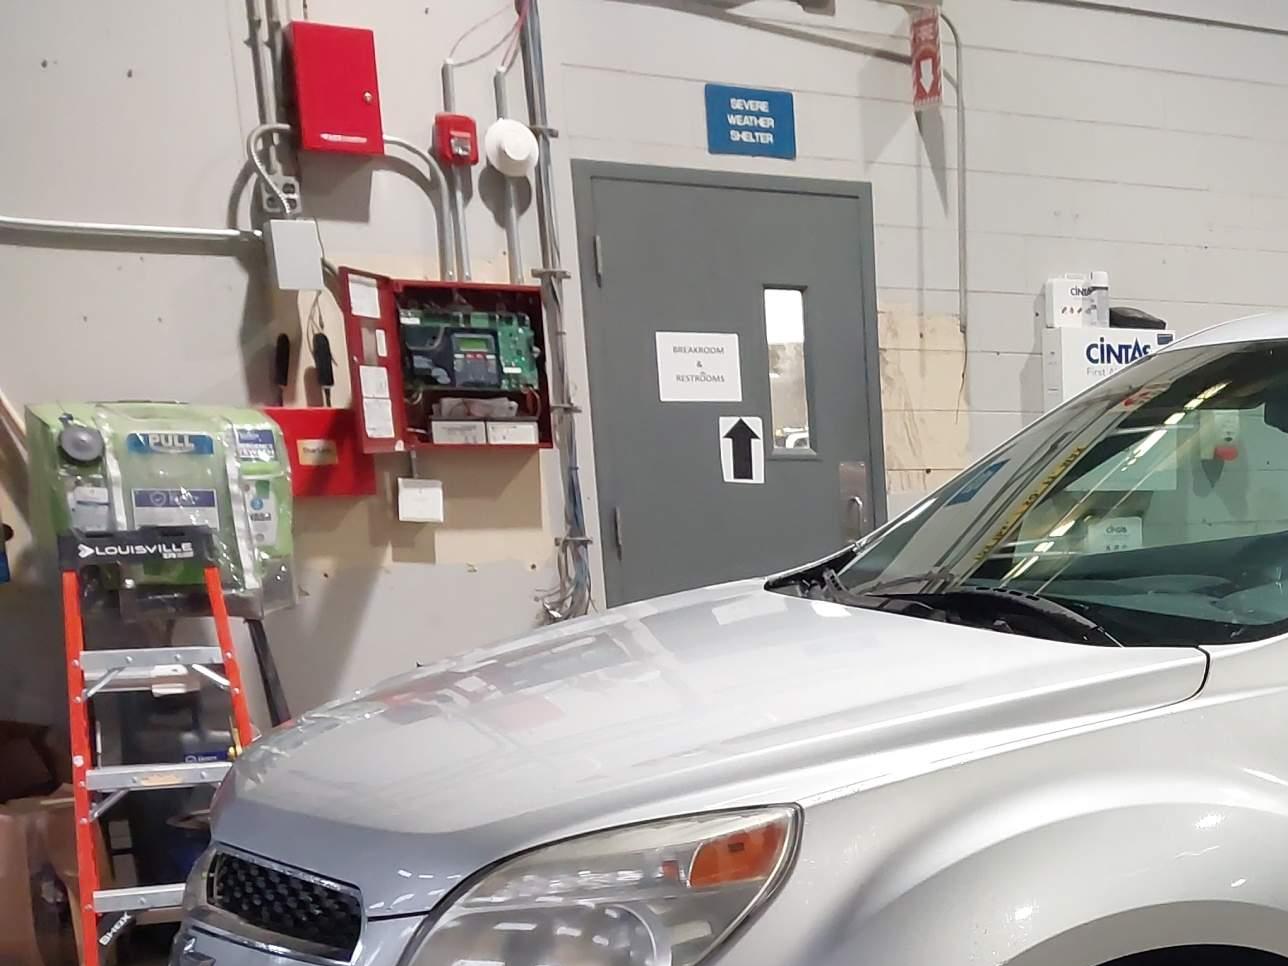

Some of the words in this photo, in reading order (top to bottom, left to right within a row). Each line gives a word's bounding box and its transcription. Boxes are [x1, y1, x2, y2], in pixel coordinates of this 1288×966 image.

[730, 98, 769, 112] SEVERE
[727, 114, 775, 128] WEATHER
[730, 130, 773, 144] SHELTER
[672, 346, 725, 354] BREAKROOM
[696, 360, 703, 369] &
[676, 374, 725, 383] RESTROOMS
[148, 433, 194, 449] PULL
[95, 542, 193, 556] LOUISVILLE
